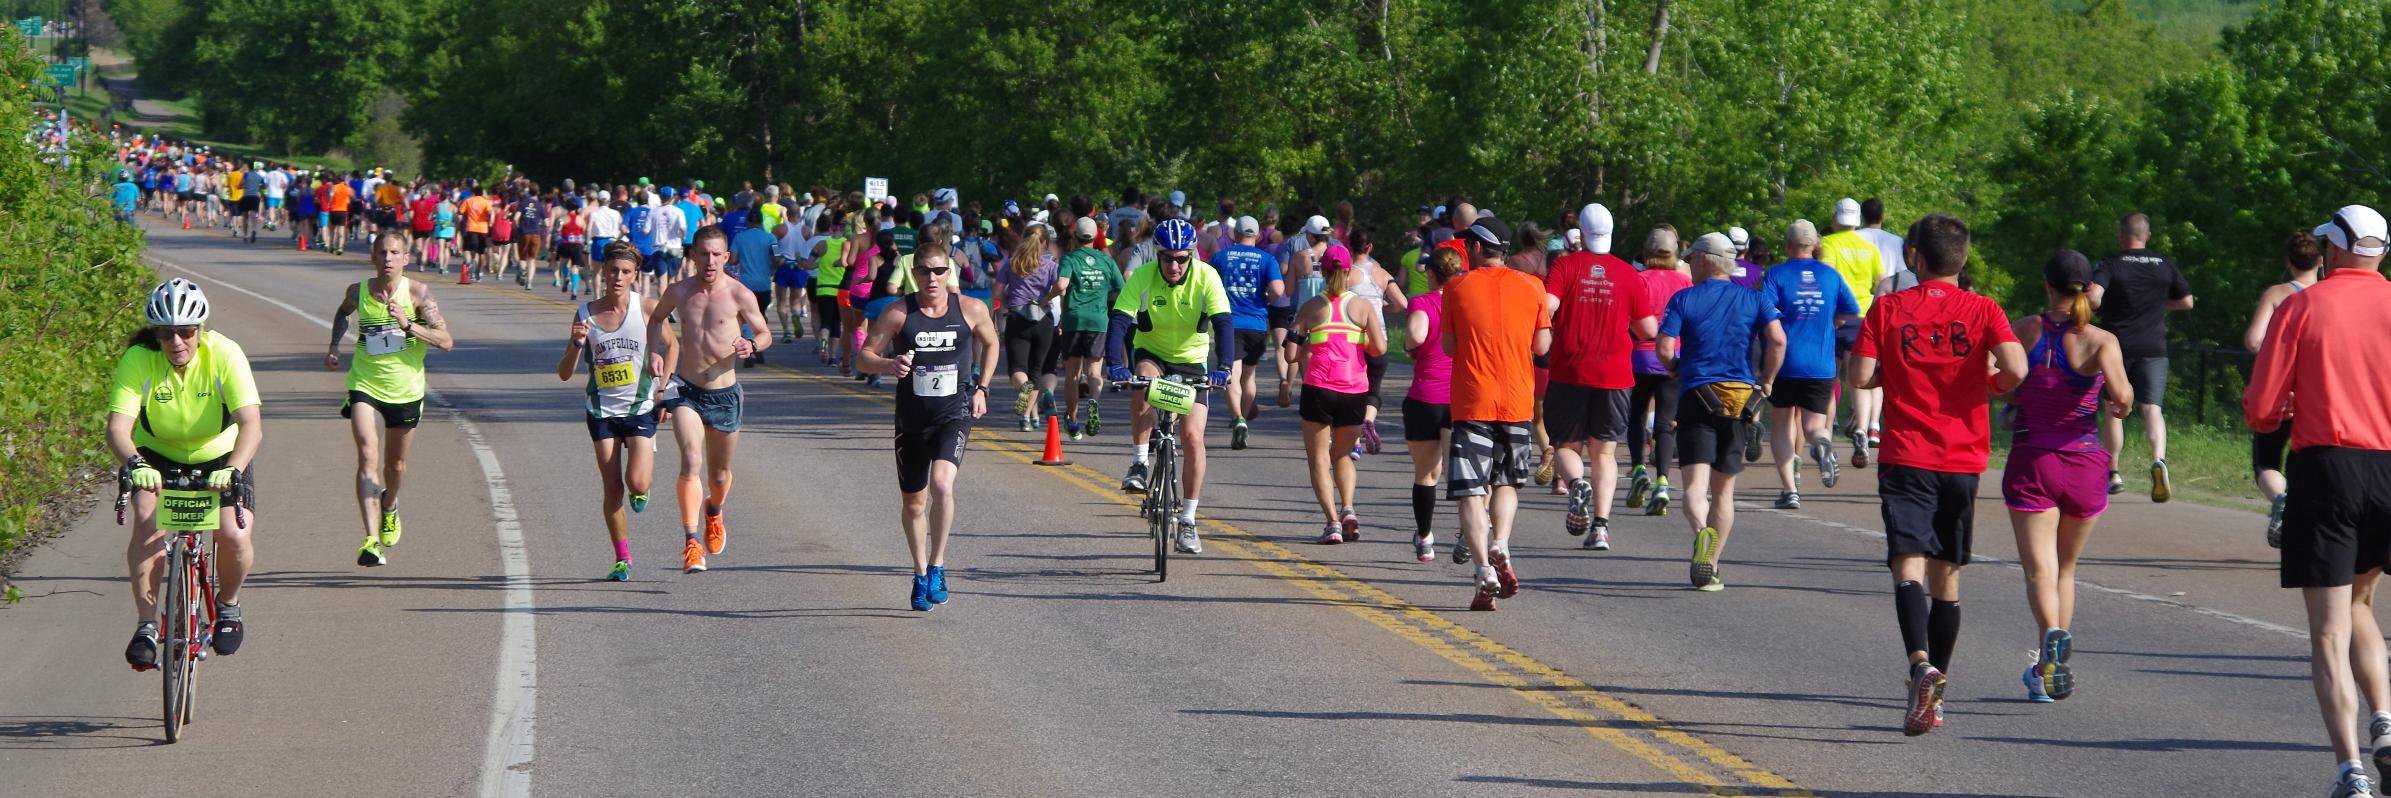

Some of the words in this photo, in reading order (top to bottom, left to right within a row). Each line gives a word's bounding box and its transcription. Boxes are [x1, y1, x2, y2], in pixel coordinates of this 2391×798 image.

[382, 335, 389, 348] 1
[915, 331, 957, 347] OUT
[1901, 323, 1925, 360] R
[1951, 321, 1971, 357] B
[601, 368, 629, 384] 6531
[932, 377, 940, 390] 2
[1157, 383, 1190, 396] OFFICIAL
[1160, 393, 1183, 404] BIKER
[164, 499, 212, 508] OFFICIAL
[172, 512, 204, 520] BIKER
